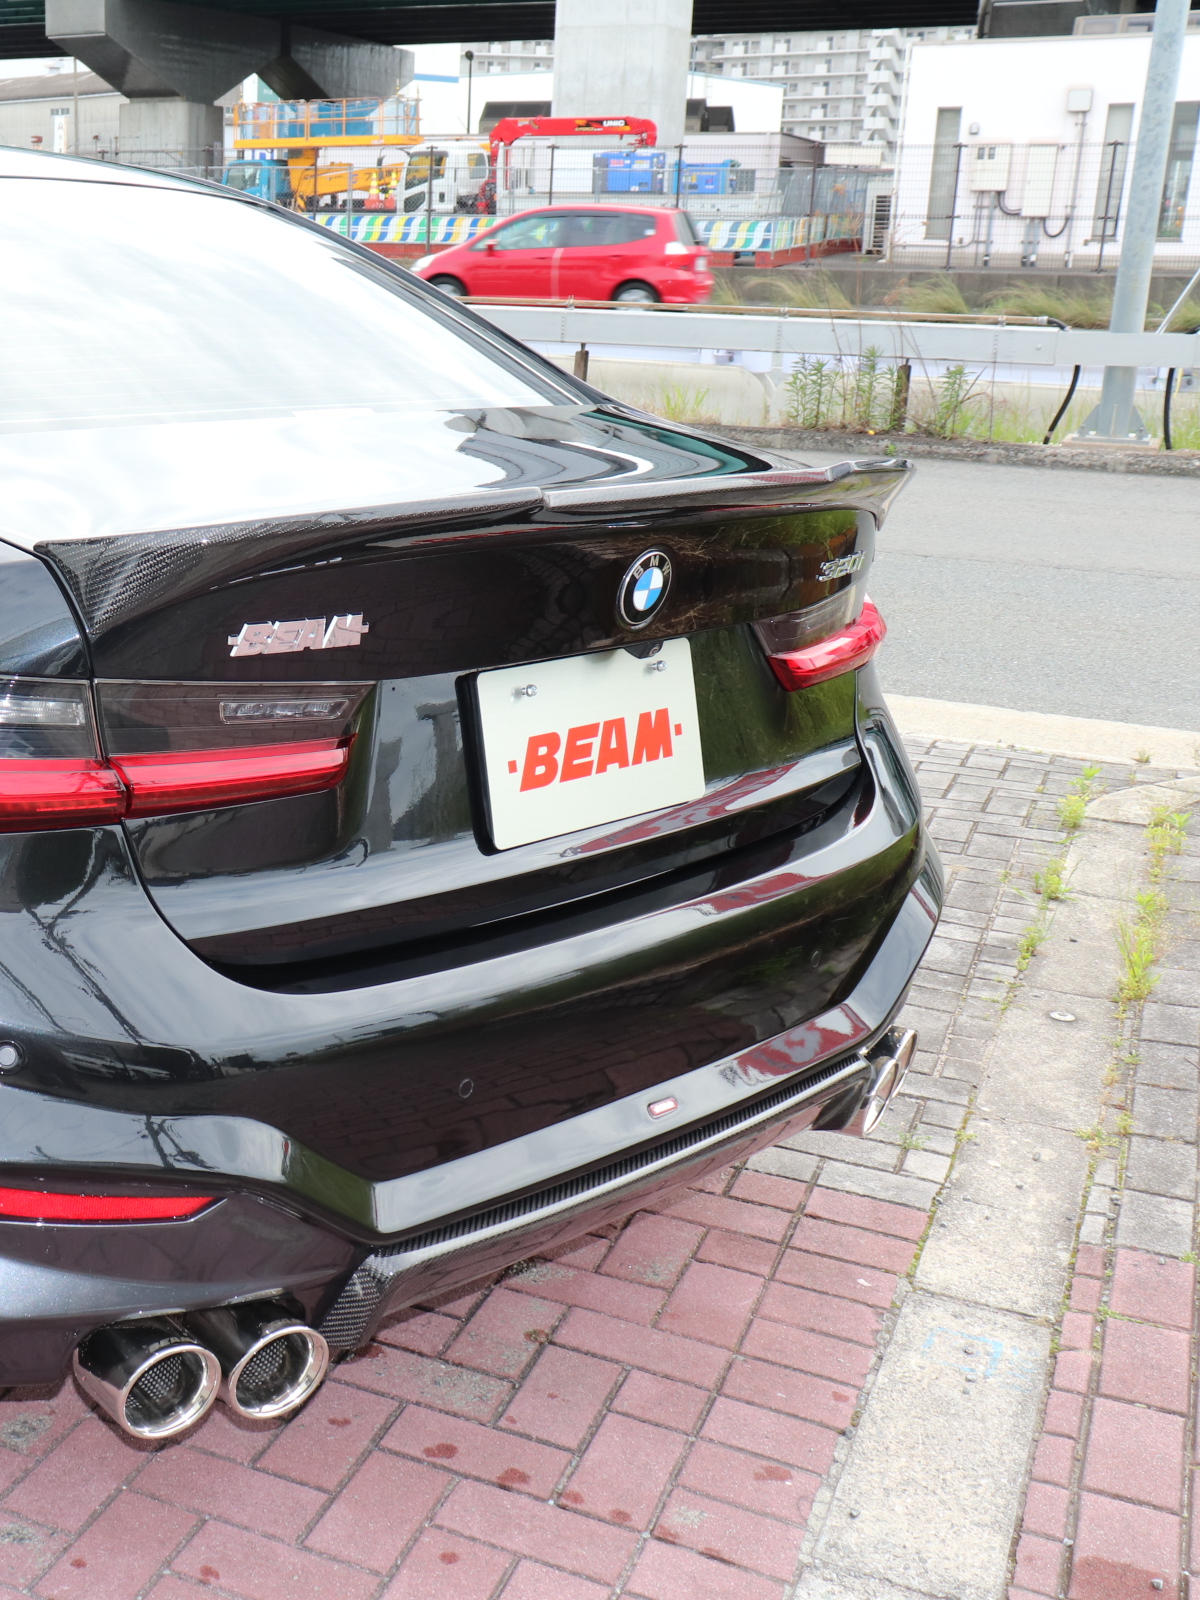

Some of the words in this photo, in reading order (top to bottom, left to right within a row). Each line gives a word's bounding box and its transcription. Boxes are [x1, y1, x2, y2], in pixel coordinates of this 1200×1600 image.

[603, 119, 626, 127] UNIC
[632, 555, 671, 580] BMW
[816, 550, 866, 582] 320i
[519, 707, 674, 793] BEAM
